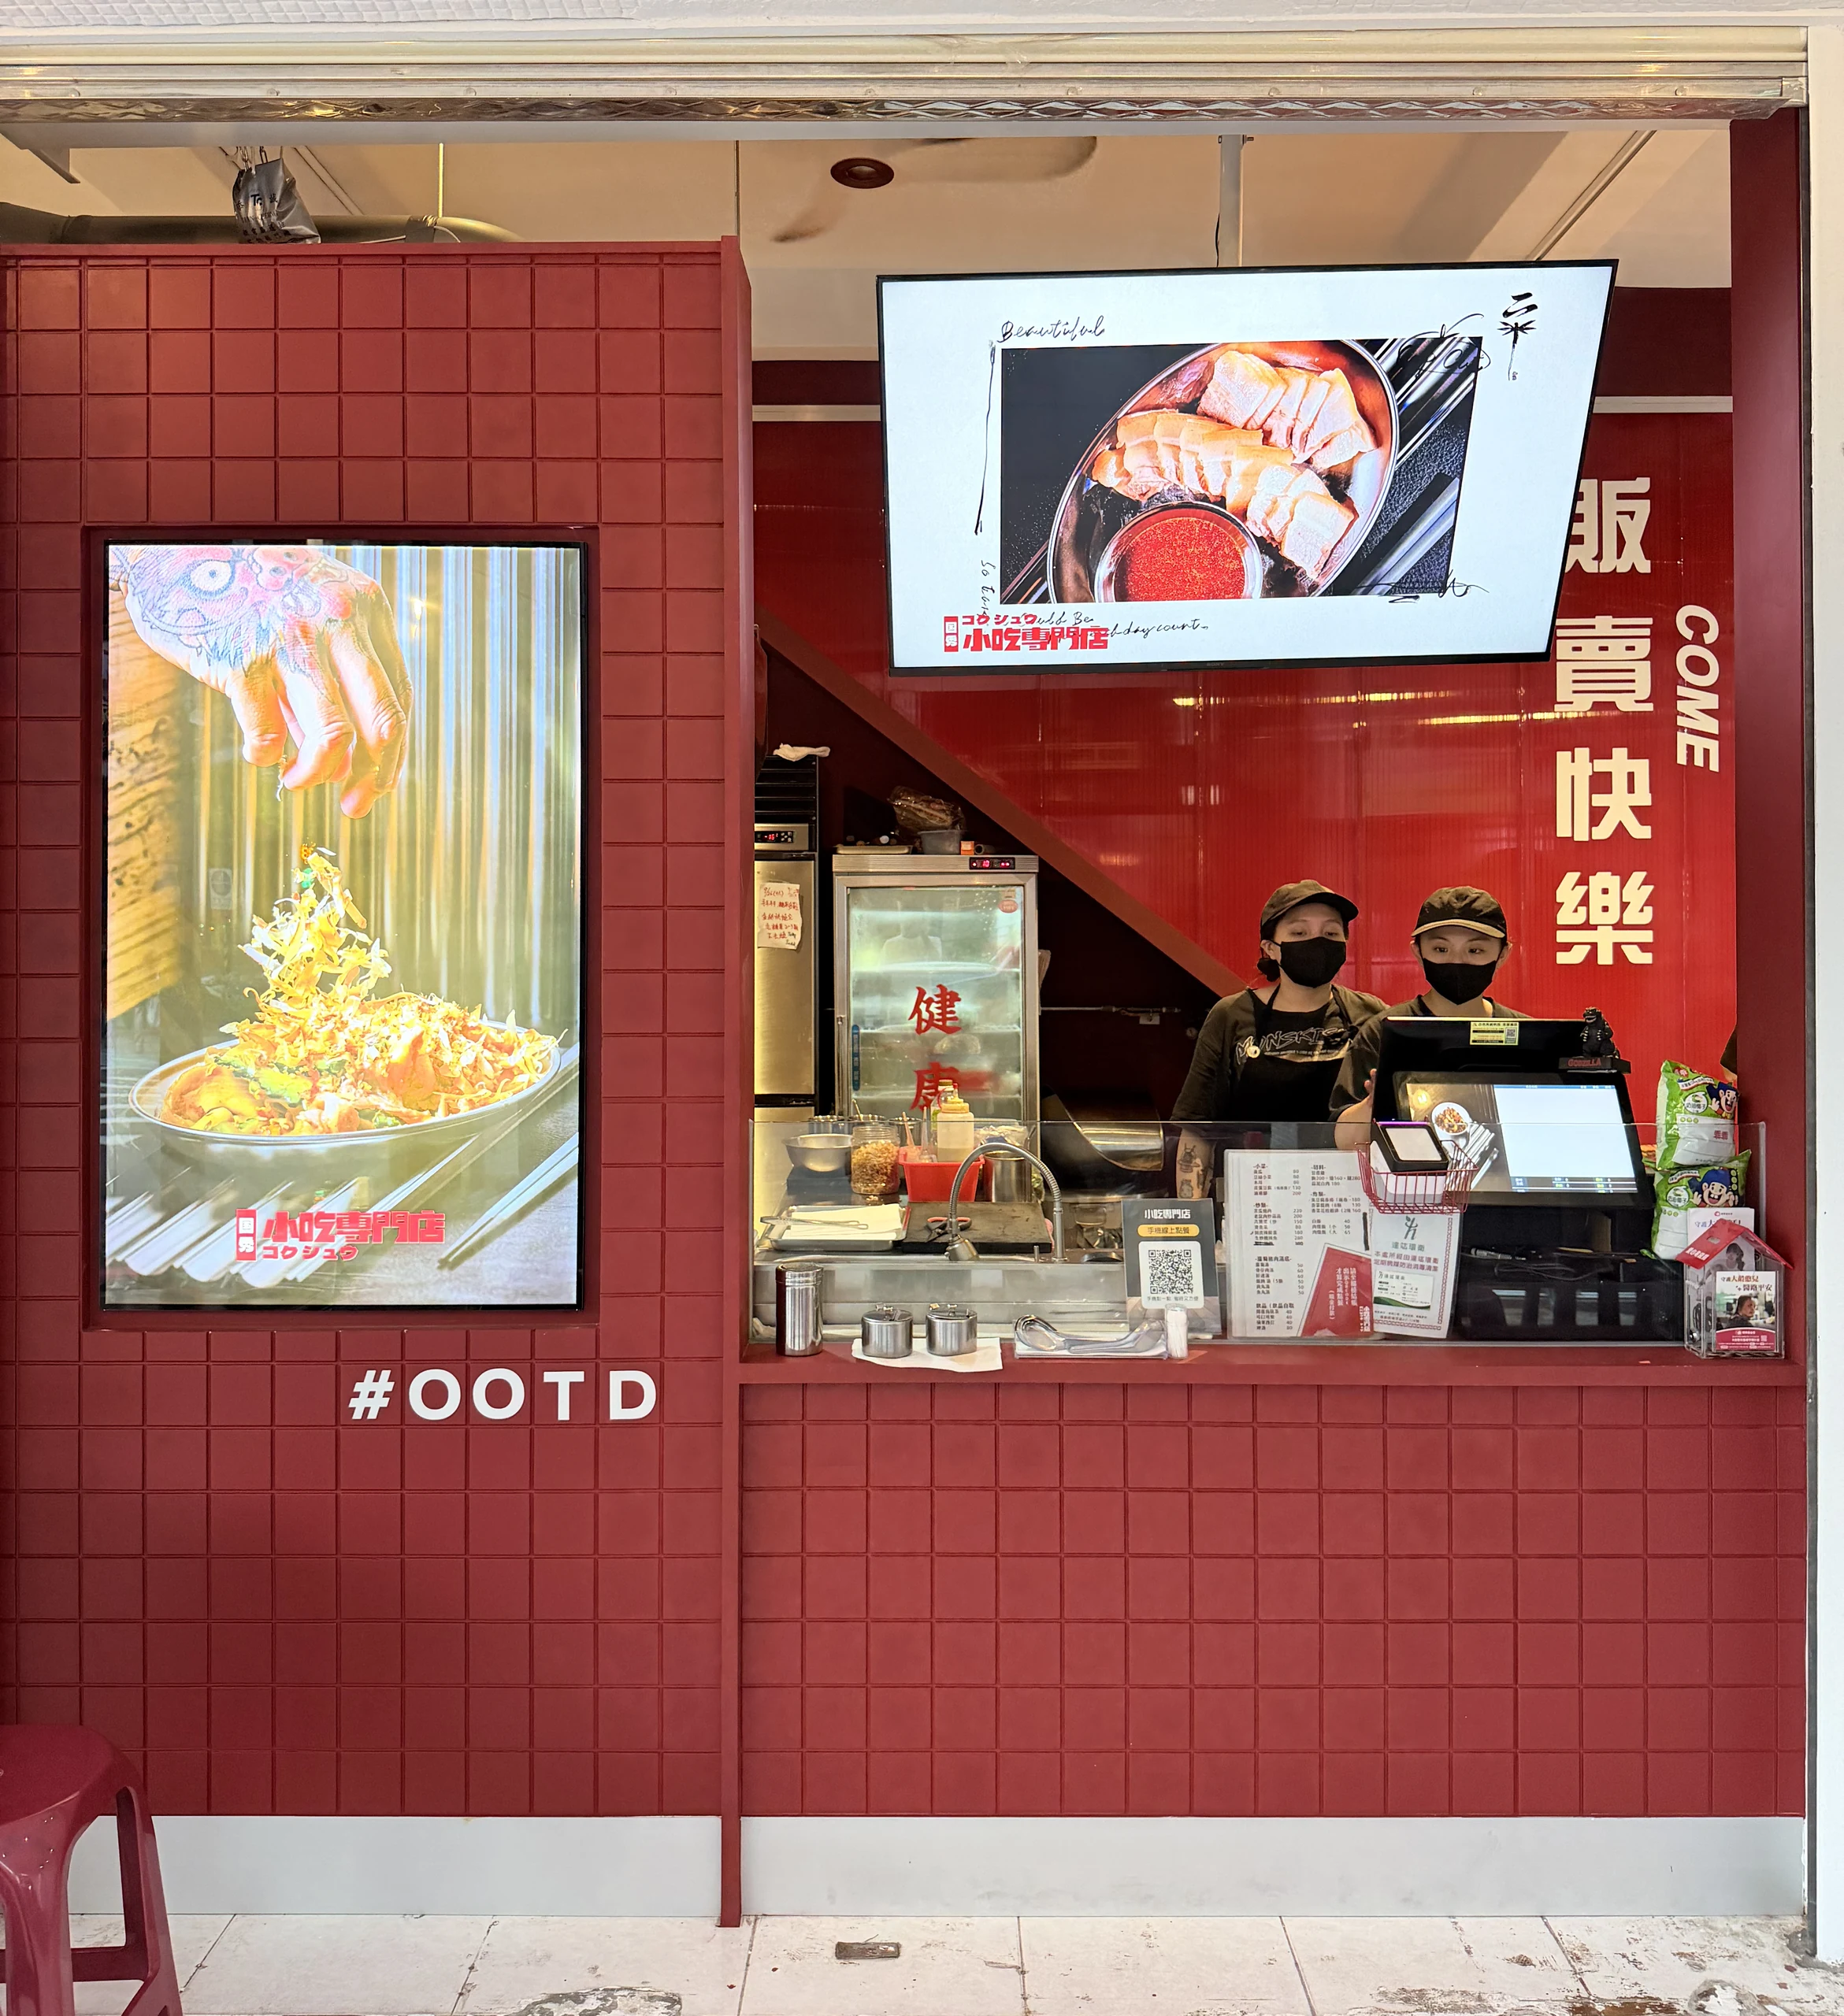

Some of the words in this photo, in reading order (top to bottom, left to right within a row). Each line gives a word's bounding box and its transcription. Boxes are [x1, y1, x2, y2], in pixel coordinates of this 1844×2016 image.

[997, 315, 1105, 343] Beautiful
[1554, 477, 1654, 966] 販賣快樂
[1675, 604, 1721, 773] COME
[348, 1368, 657, 1421] #OOTD
